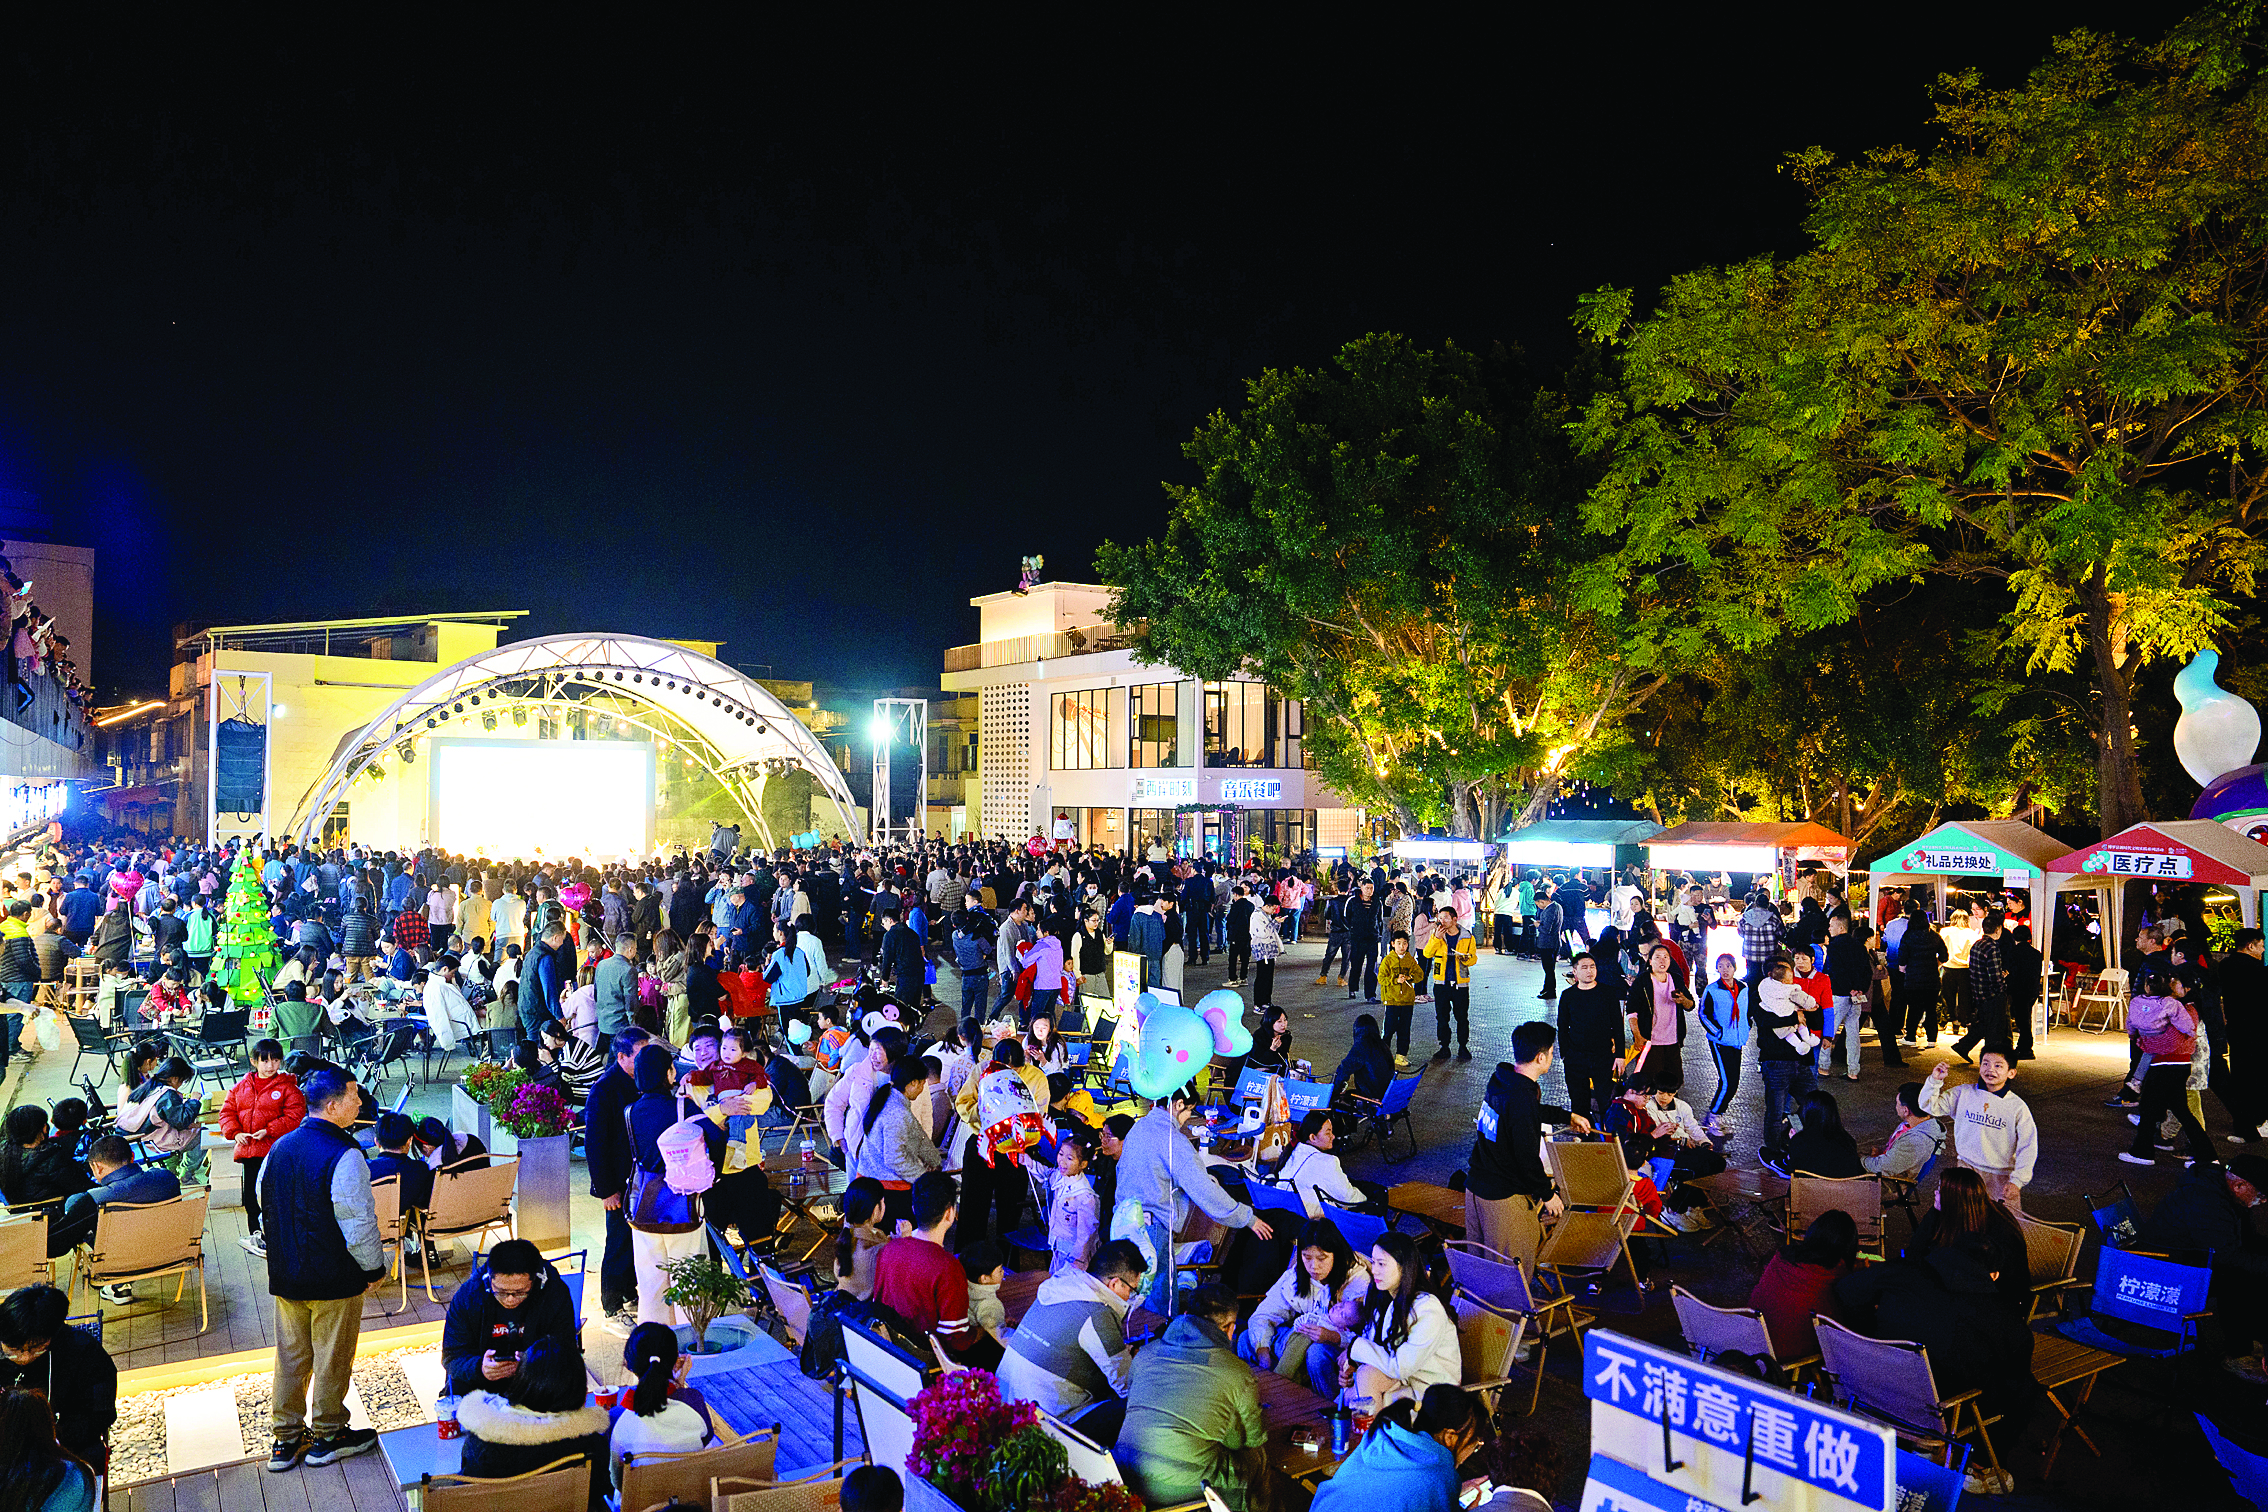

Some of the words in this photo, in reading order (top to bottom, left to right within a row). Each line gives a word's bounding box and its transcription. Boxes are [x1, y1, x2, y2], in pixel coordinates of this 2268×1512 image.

[1147, 780, 1192, 796] 西岸时刻
[1223, 779, 1281, 799] 音乐餐吧
[1926, 855, 1991, 869] 礼品兑换处
[2113, 854, 2178, 875] 医疗点
[1965, 1110, 2007, 1128] AninKids
[2119, 1275, 2180, 1305] 柠濛濛
[1595, 1346, 1860, 1493] 不满意重做
